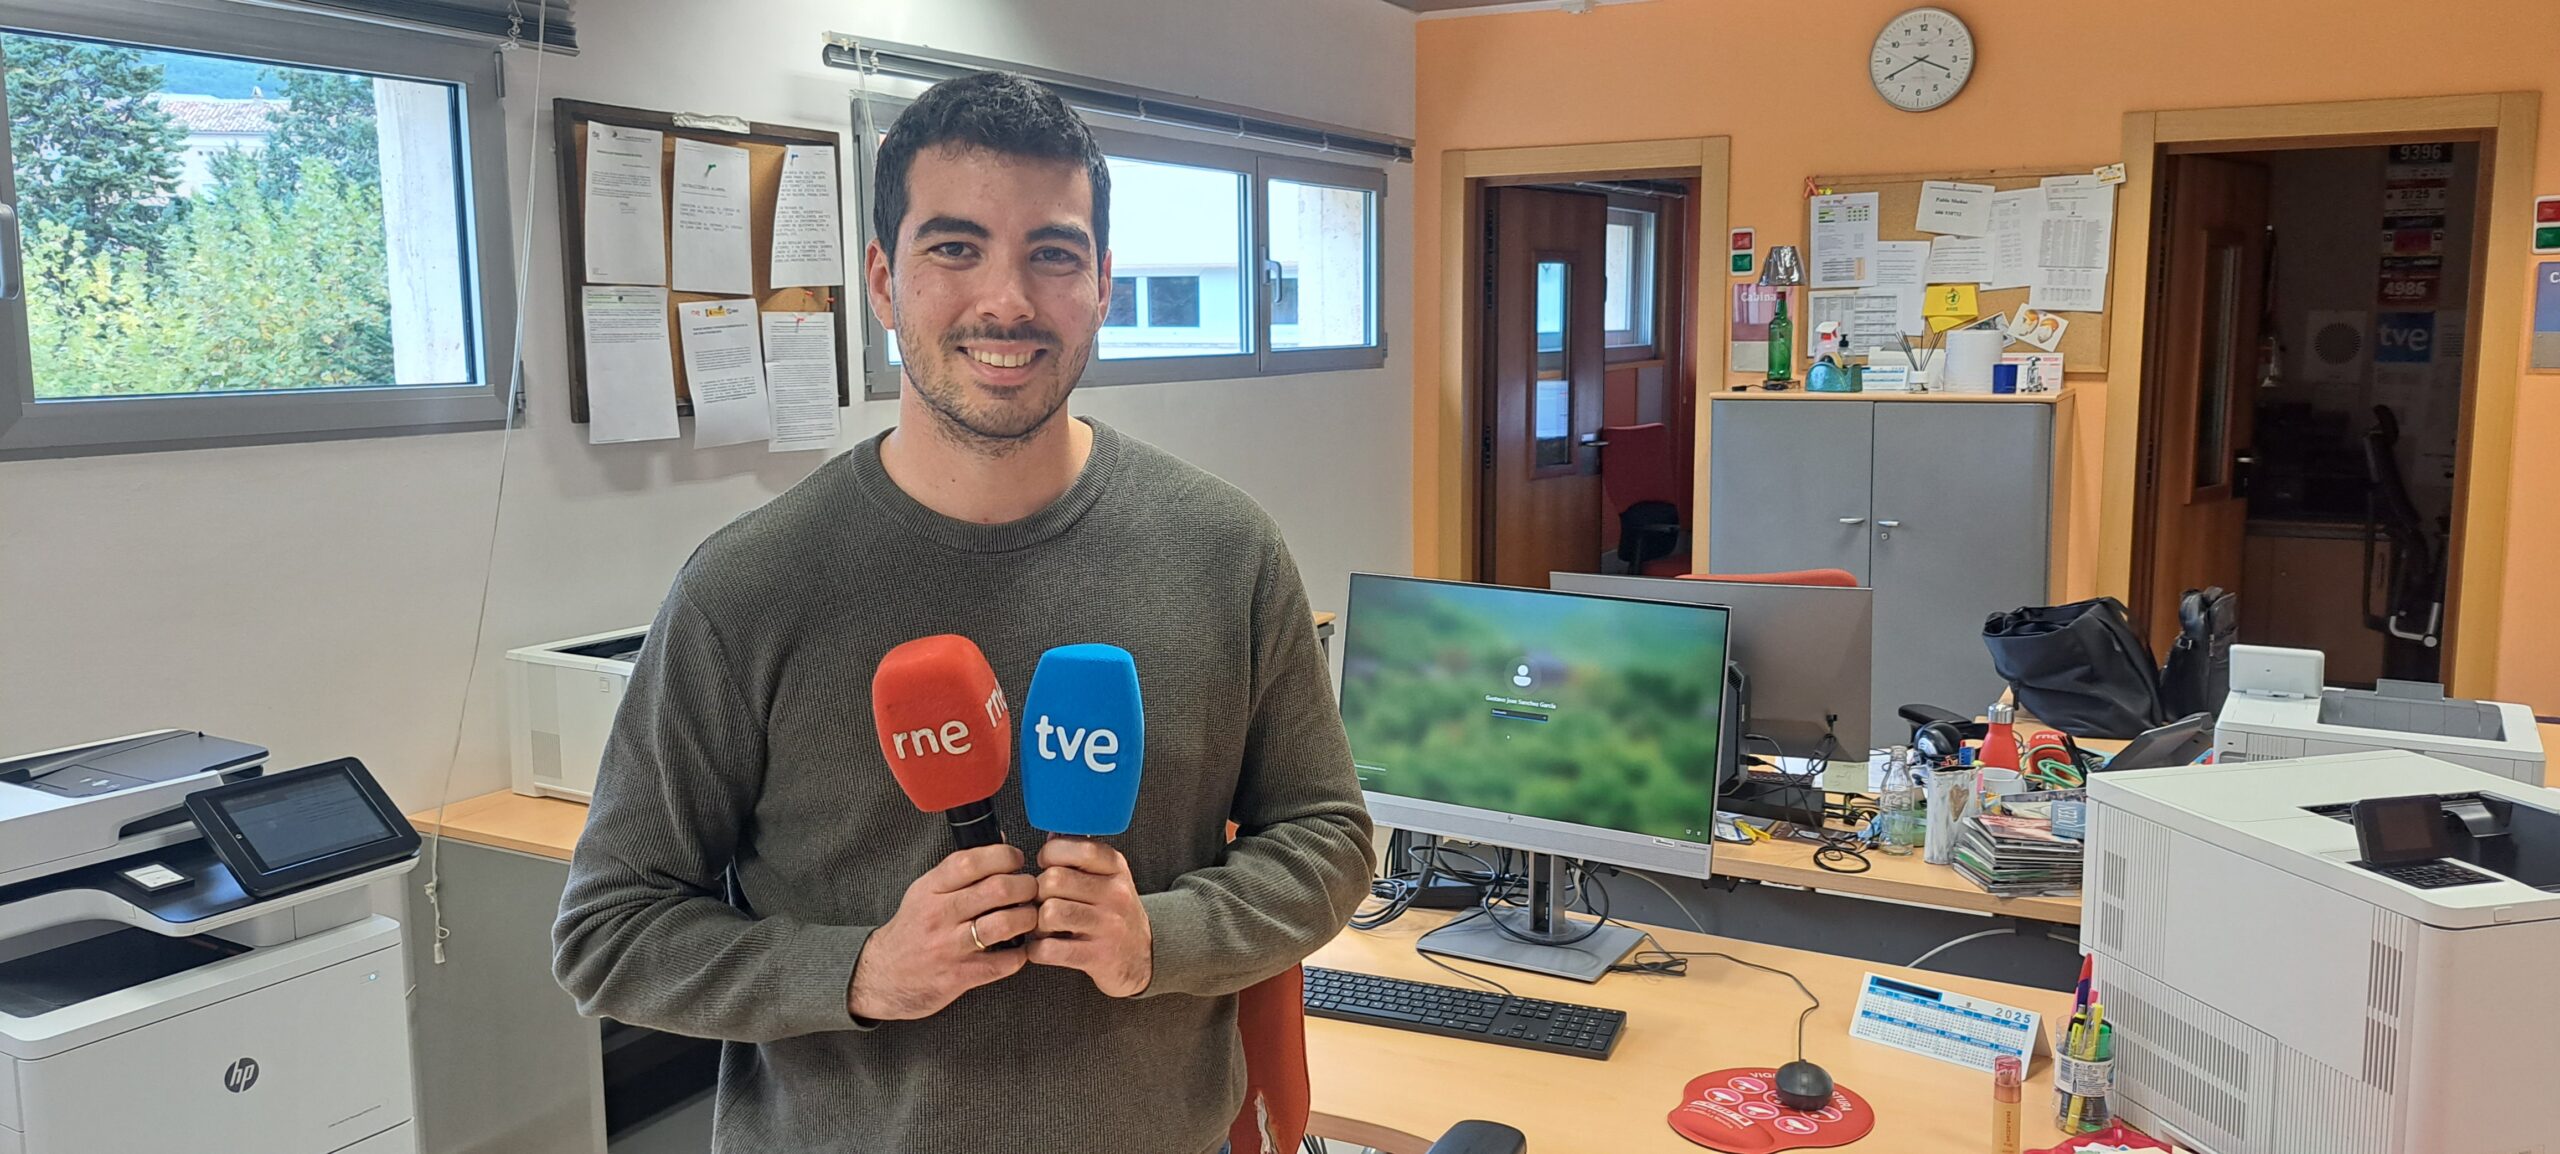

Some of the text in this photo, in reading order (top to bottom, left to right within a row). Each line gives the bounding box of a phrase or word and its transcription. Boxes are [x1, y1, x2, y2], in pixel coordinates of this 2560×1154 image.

[1948, 39, 1954, 47] 2
[1951, 55, 1958, 63] 3
[2401, 144, 2441, 160] 9396
[1740, 291, 1777, 302] Cabina
[2383, 281, 2427, 296] 4986
[2380, 323, 2429, 351] tve
[892, 720, 972, 760] rne
[1035, 715, 1118, 773] tve
[1995, 1007, 2031, 1024] 2025
[228, 1057, 257, 1093] hp
